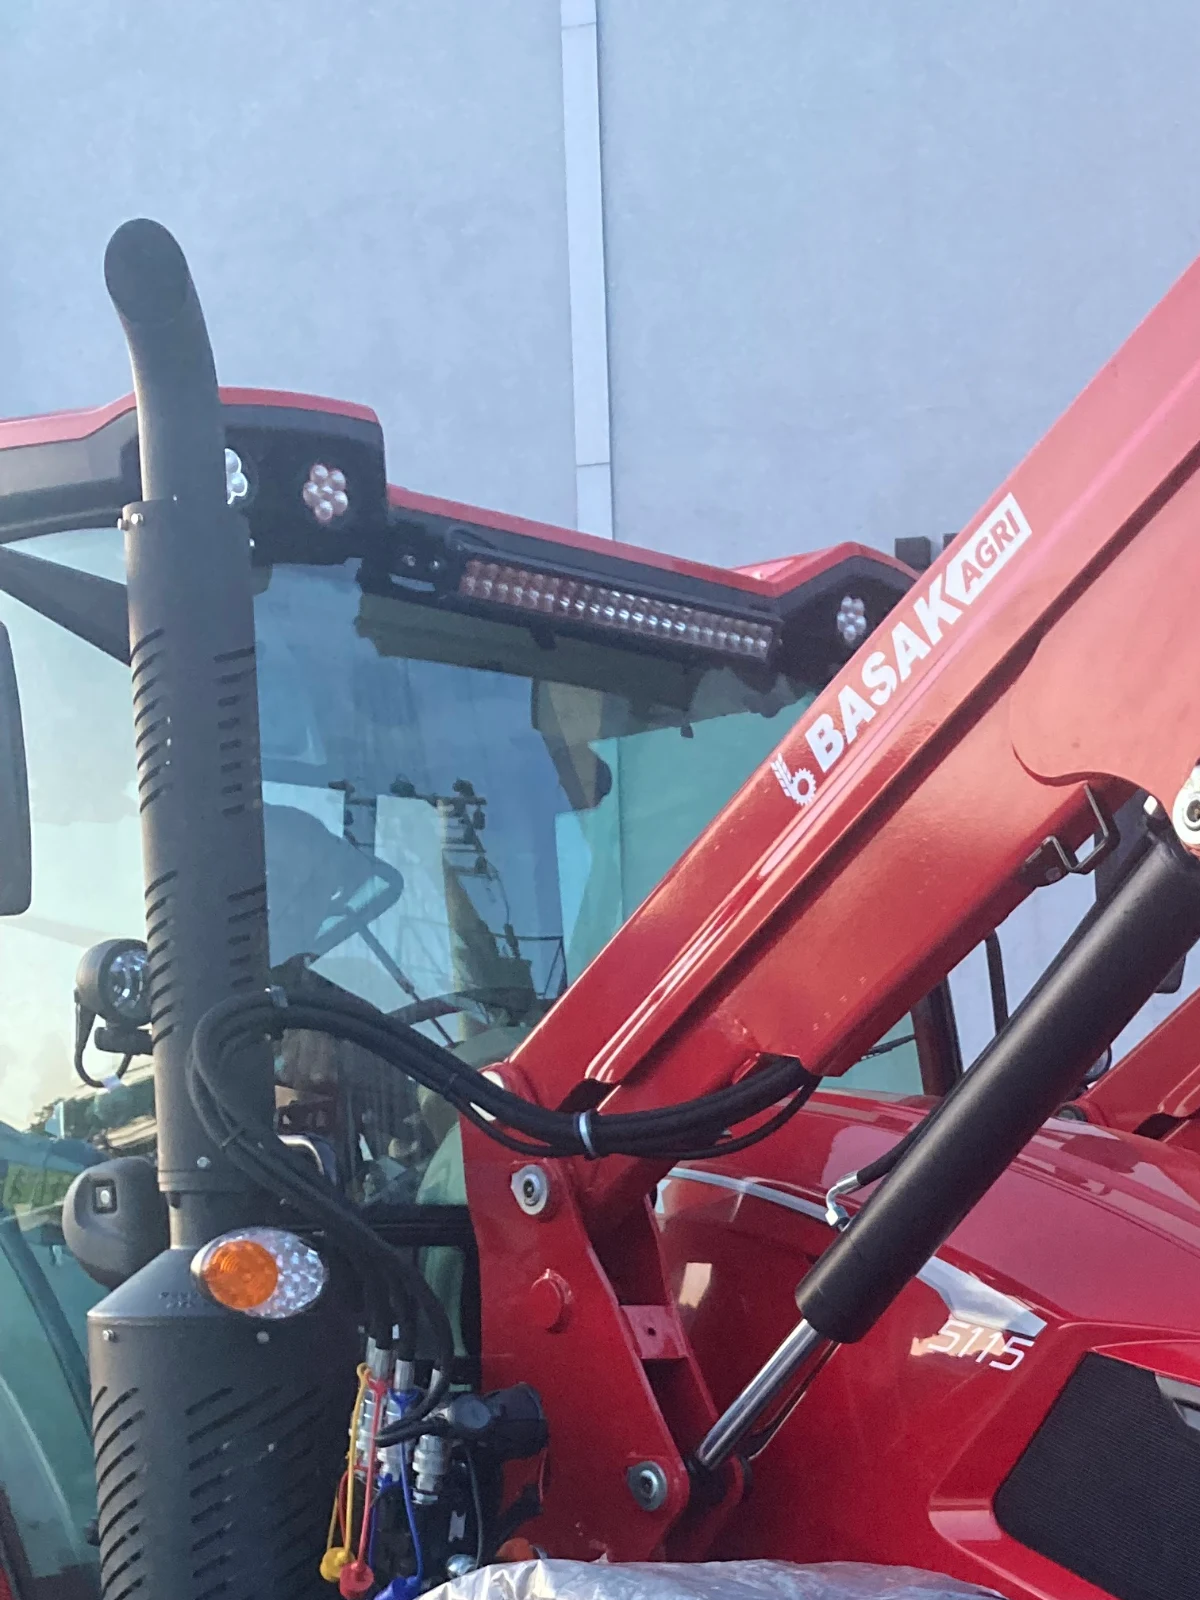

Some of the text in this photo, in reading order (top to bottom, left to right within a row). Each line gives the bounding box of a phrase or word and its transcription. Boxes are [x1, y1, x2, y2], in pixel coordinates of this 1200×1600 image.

[805, 507, 1022, 774] BASAK AGRI
[927, 1318, 1035, 1372] 5115
